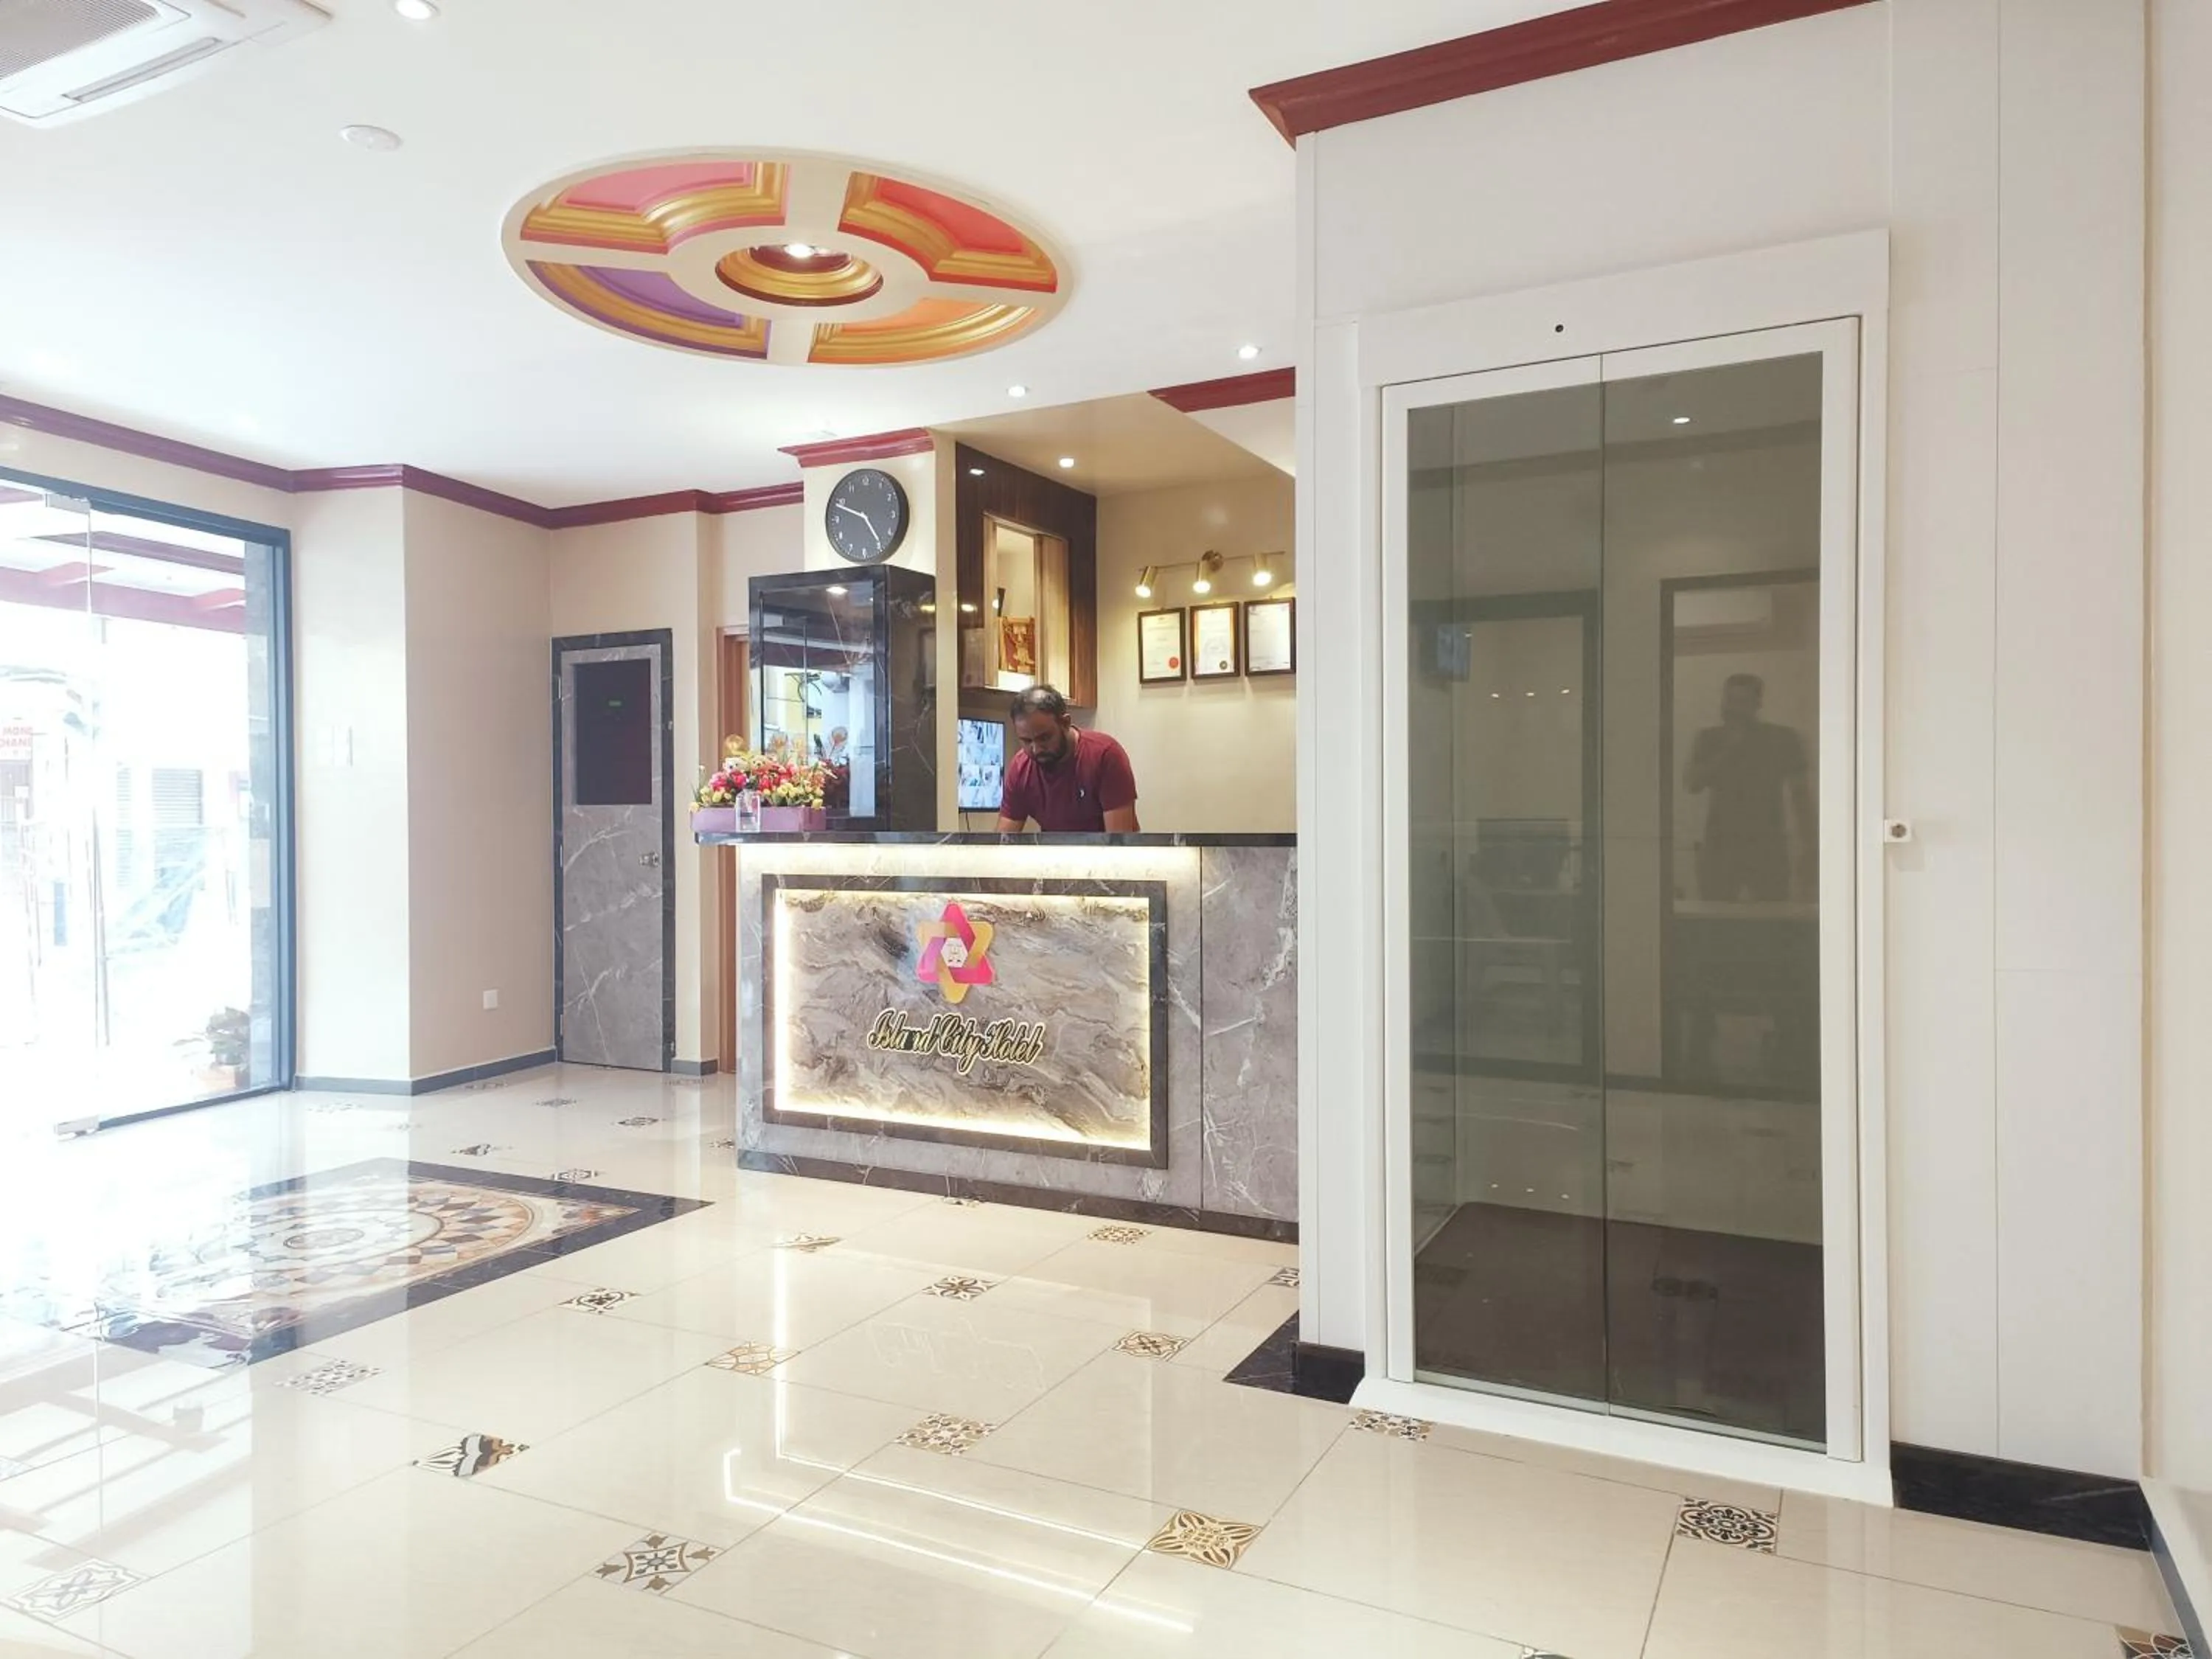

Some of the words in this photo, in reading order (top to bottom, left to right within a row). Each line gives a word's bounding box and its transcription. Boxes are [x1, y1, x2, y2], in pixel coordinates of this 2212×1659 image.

[868, 1009, 942, 1054] Island
[939, 1013, 982, 1075] City
[978, 1018, 1044, 1064] Hotel
